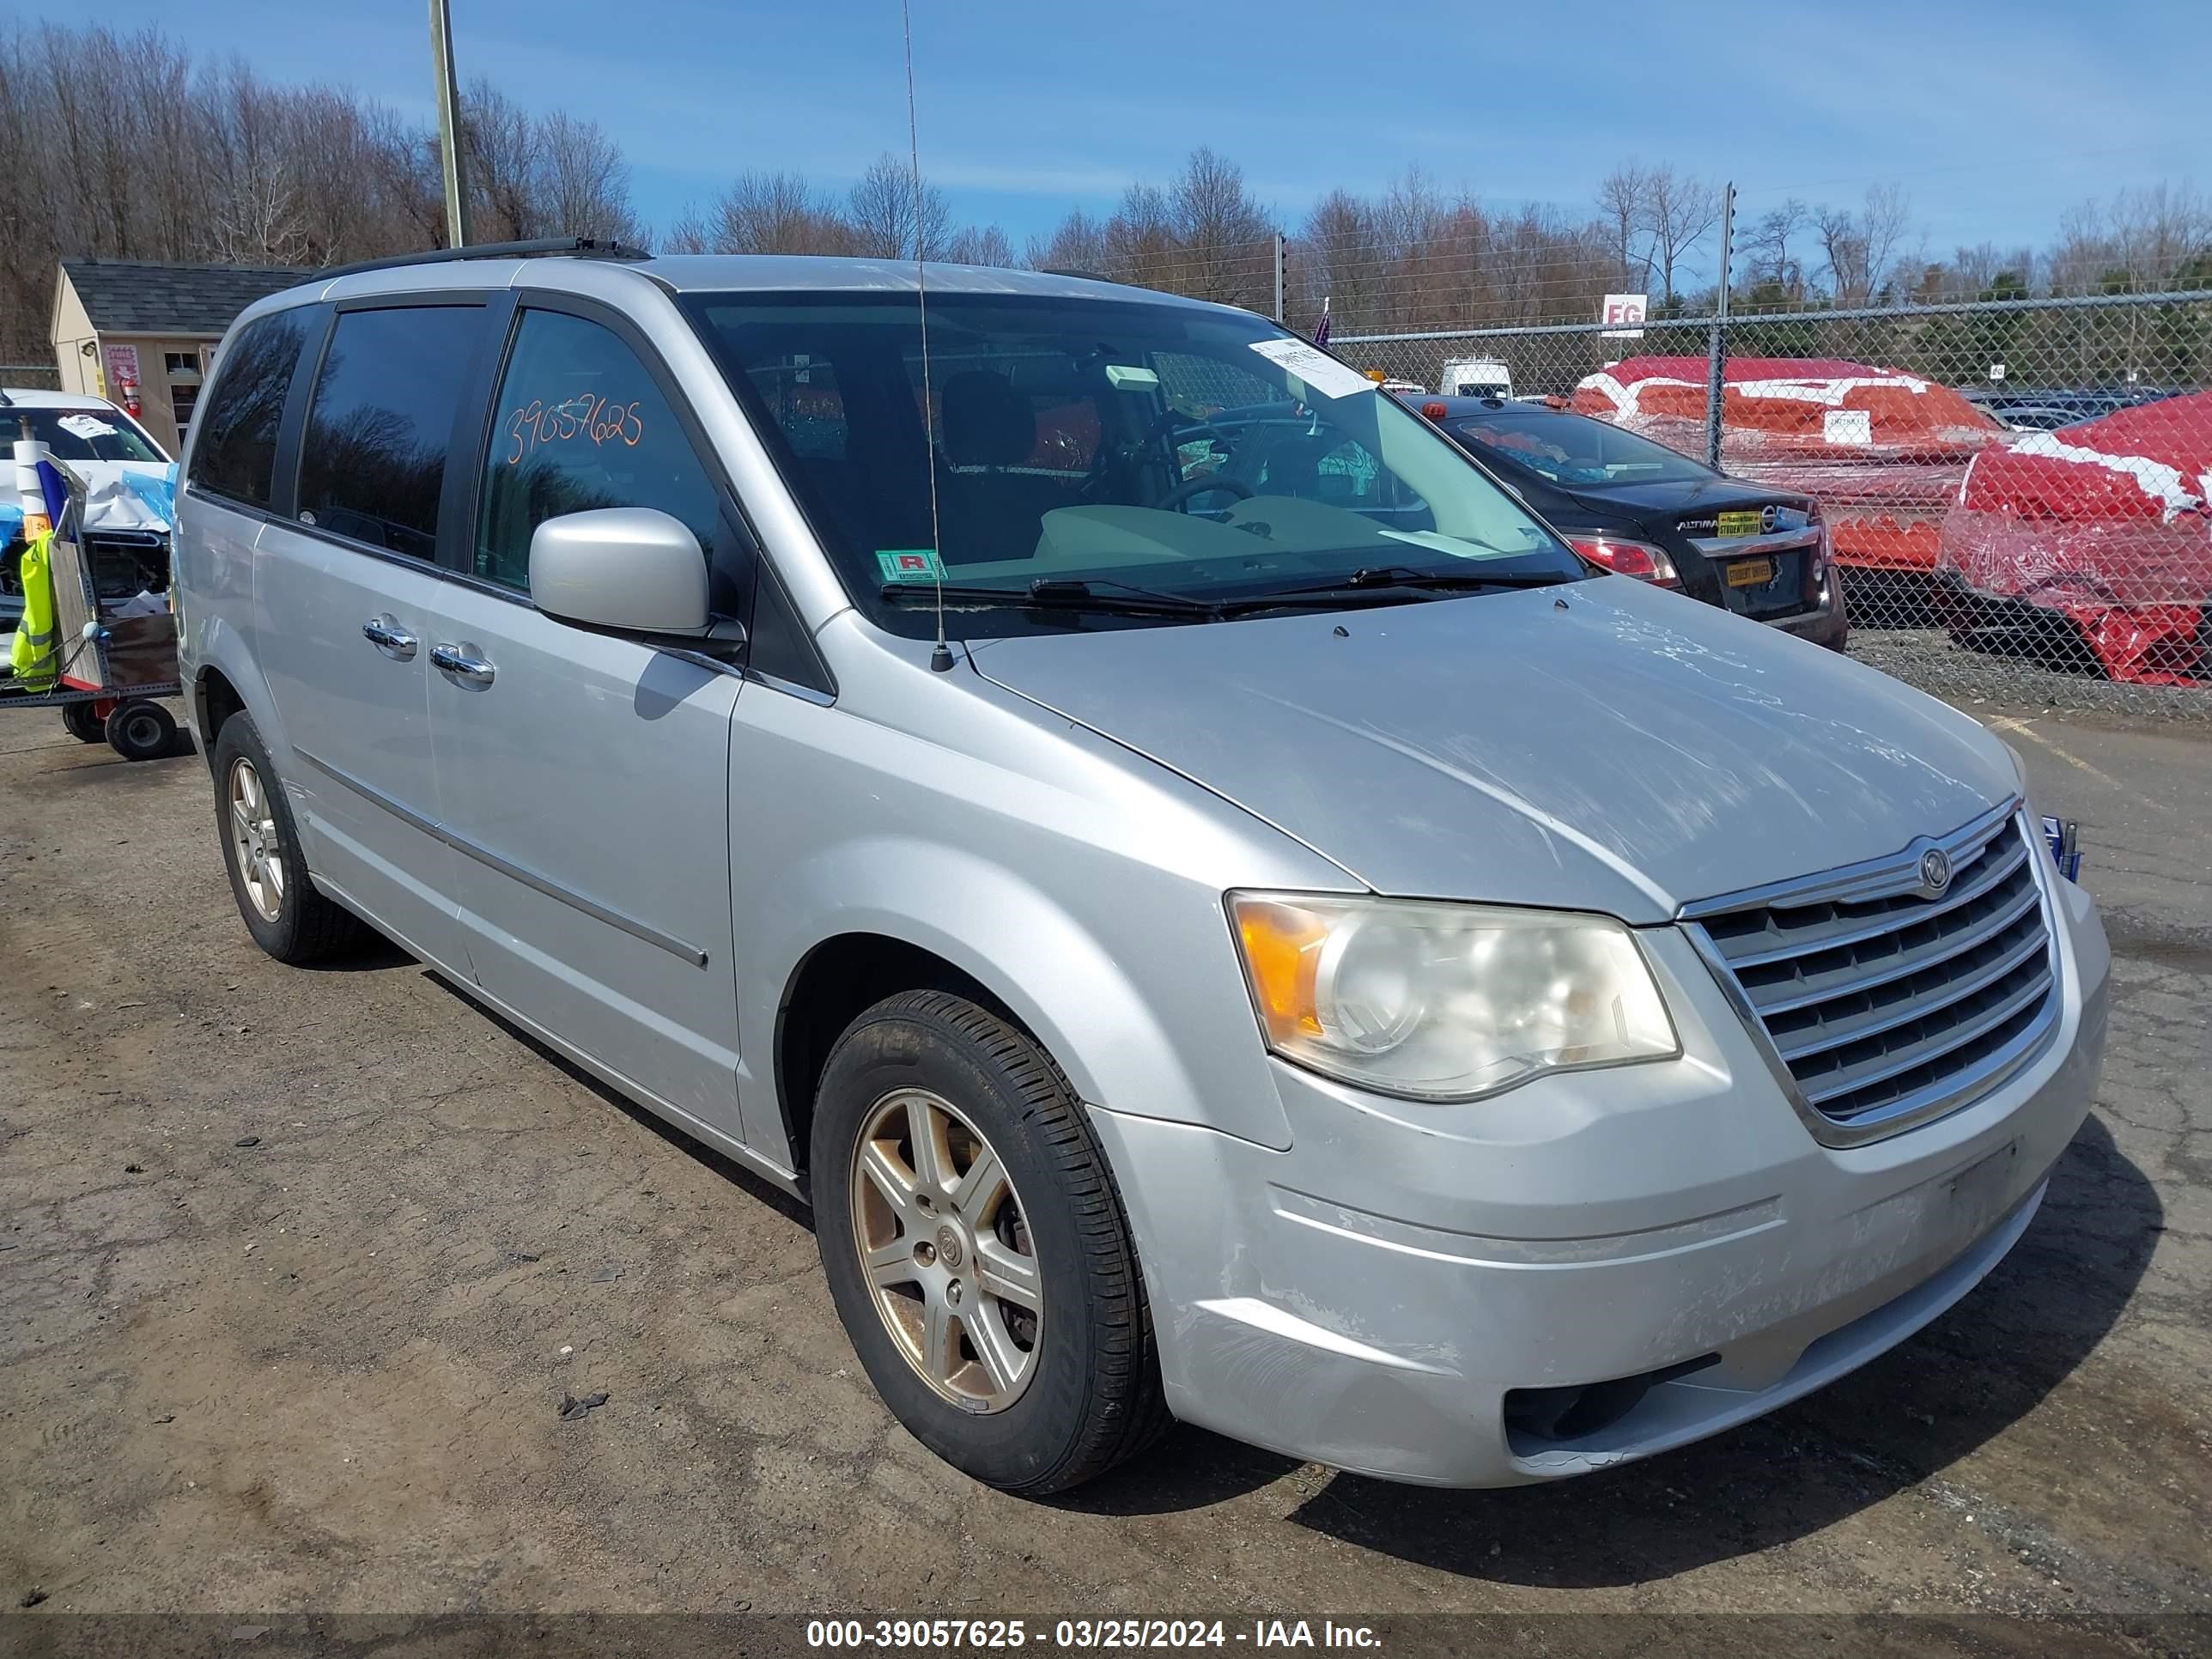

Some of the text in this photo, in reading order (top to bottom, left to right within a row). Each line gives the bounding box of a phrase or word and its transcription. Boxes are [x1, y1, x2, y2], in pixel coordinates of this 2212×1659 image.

[505, 393, 642, 464] 39057625
[1676, 520, 1717, 532] ALTIMA
[1720, 525, 1743, 534] STUDENT
[899, 556, 927, 569] R
